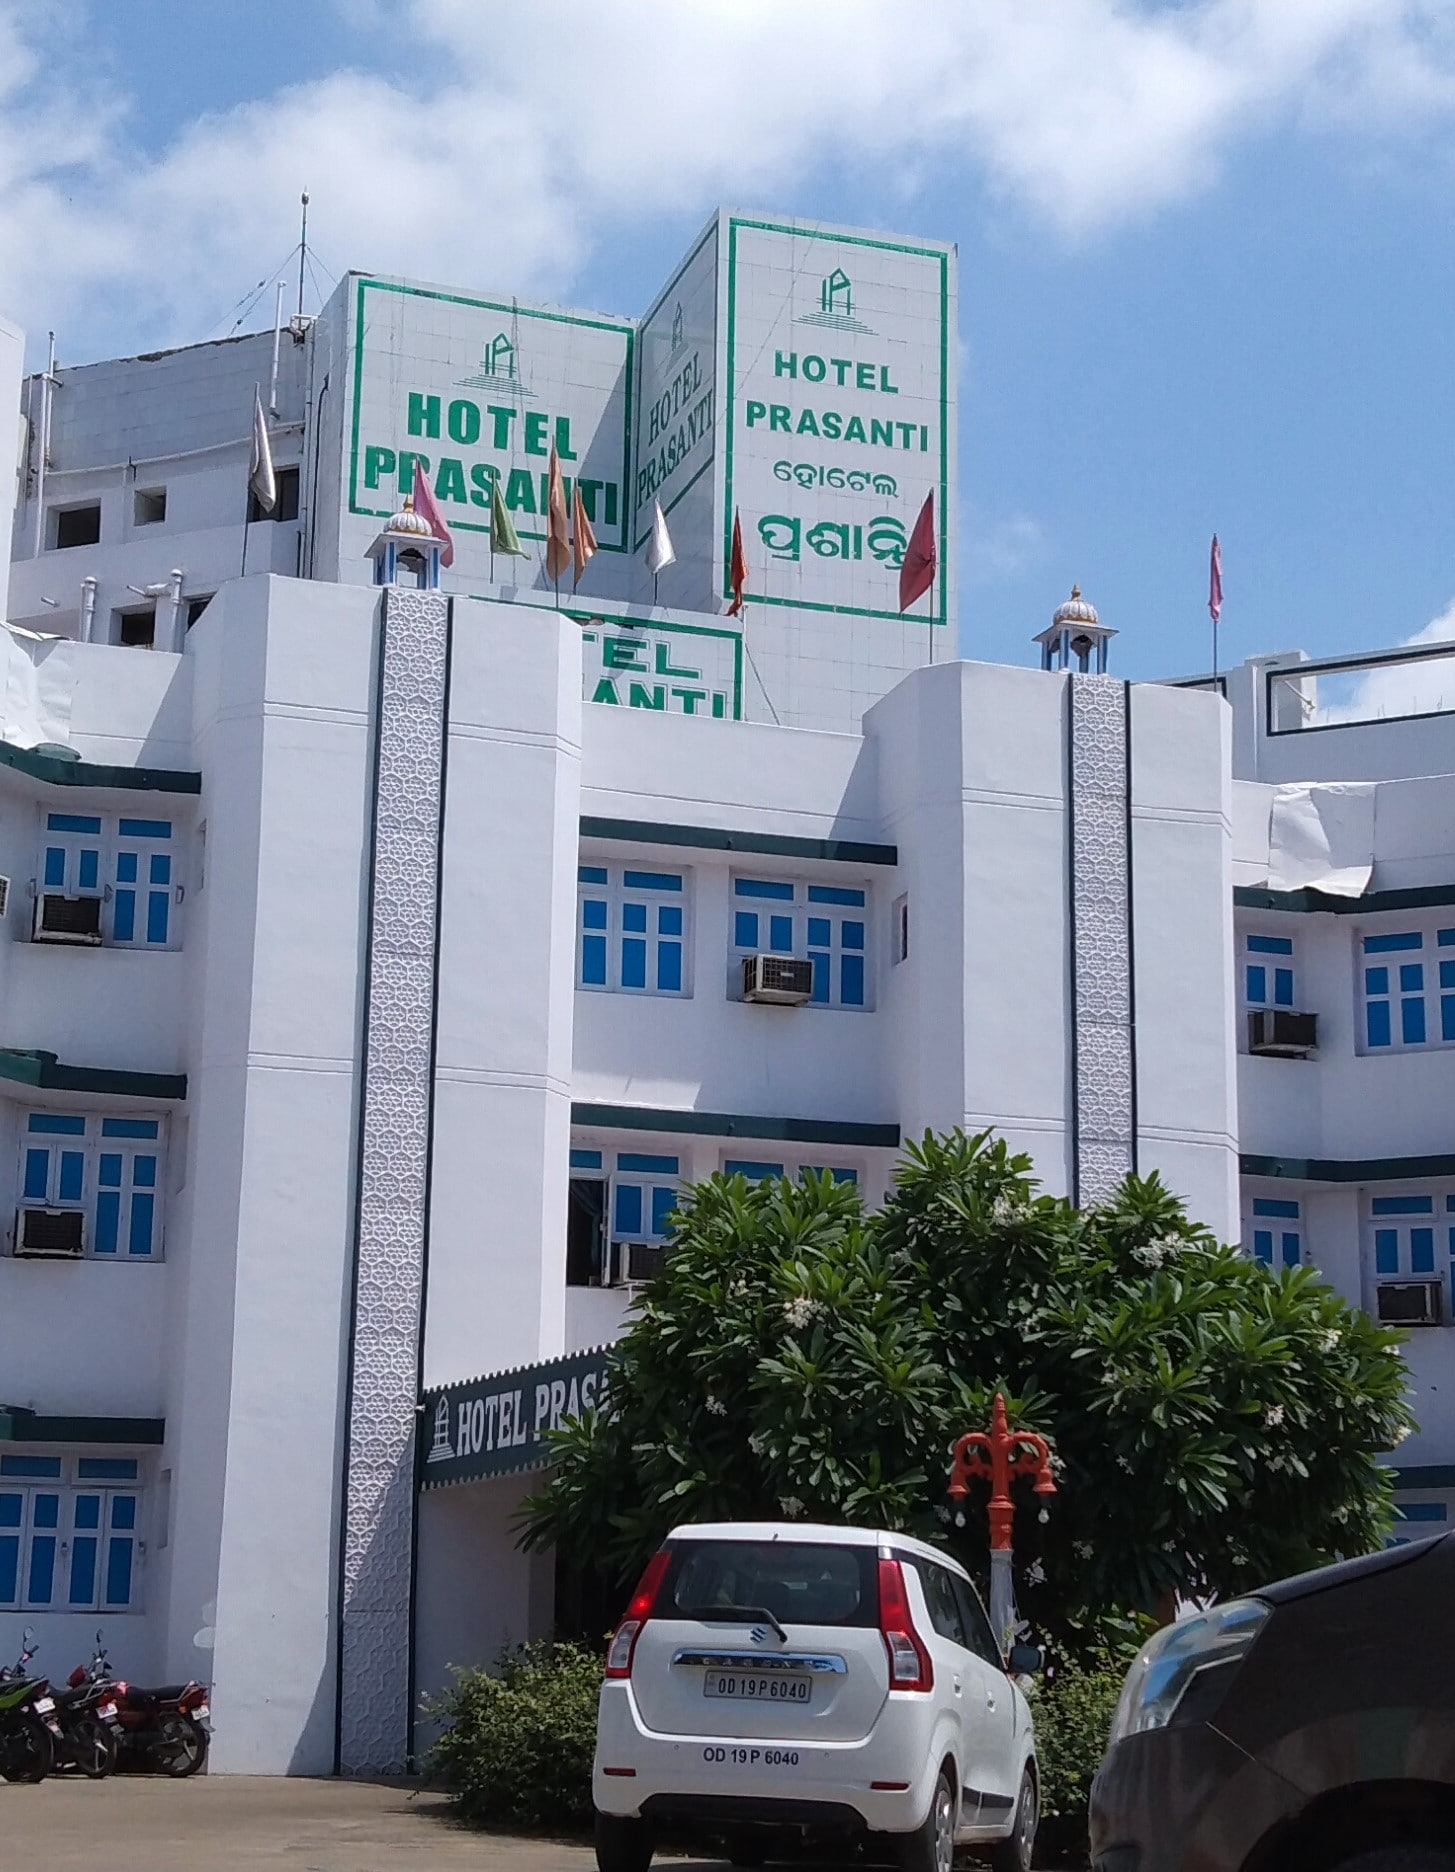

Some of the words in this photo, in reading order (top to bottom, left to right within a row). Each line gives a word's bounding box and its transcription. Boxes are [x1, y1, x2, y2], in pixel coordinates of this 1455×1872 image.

[648, 352, 703, 447] HOTEL
[774, 350, 899, 394] HOTEL
[407, 391, 578, 461] HOTEL
[637, 388, 713, 511] PRASANTI
[746, 400, 928, 452] PRASANTI
[456, 1389, 528, 1457] HOTEL
[770, 1681, 806, 1699] 6040
[703, 1747, 726, 1762] OD
[730, 1748, 747, 1764] 19
[750, 1749, 760, 1764] P
[764, 1751, 799, 1766] 6040
